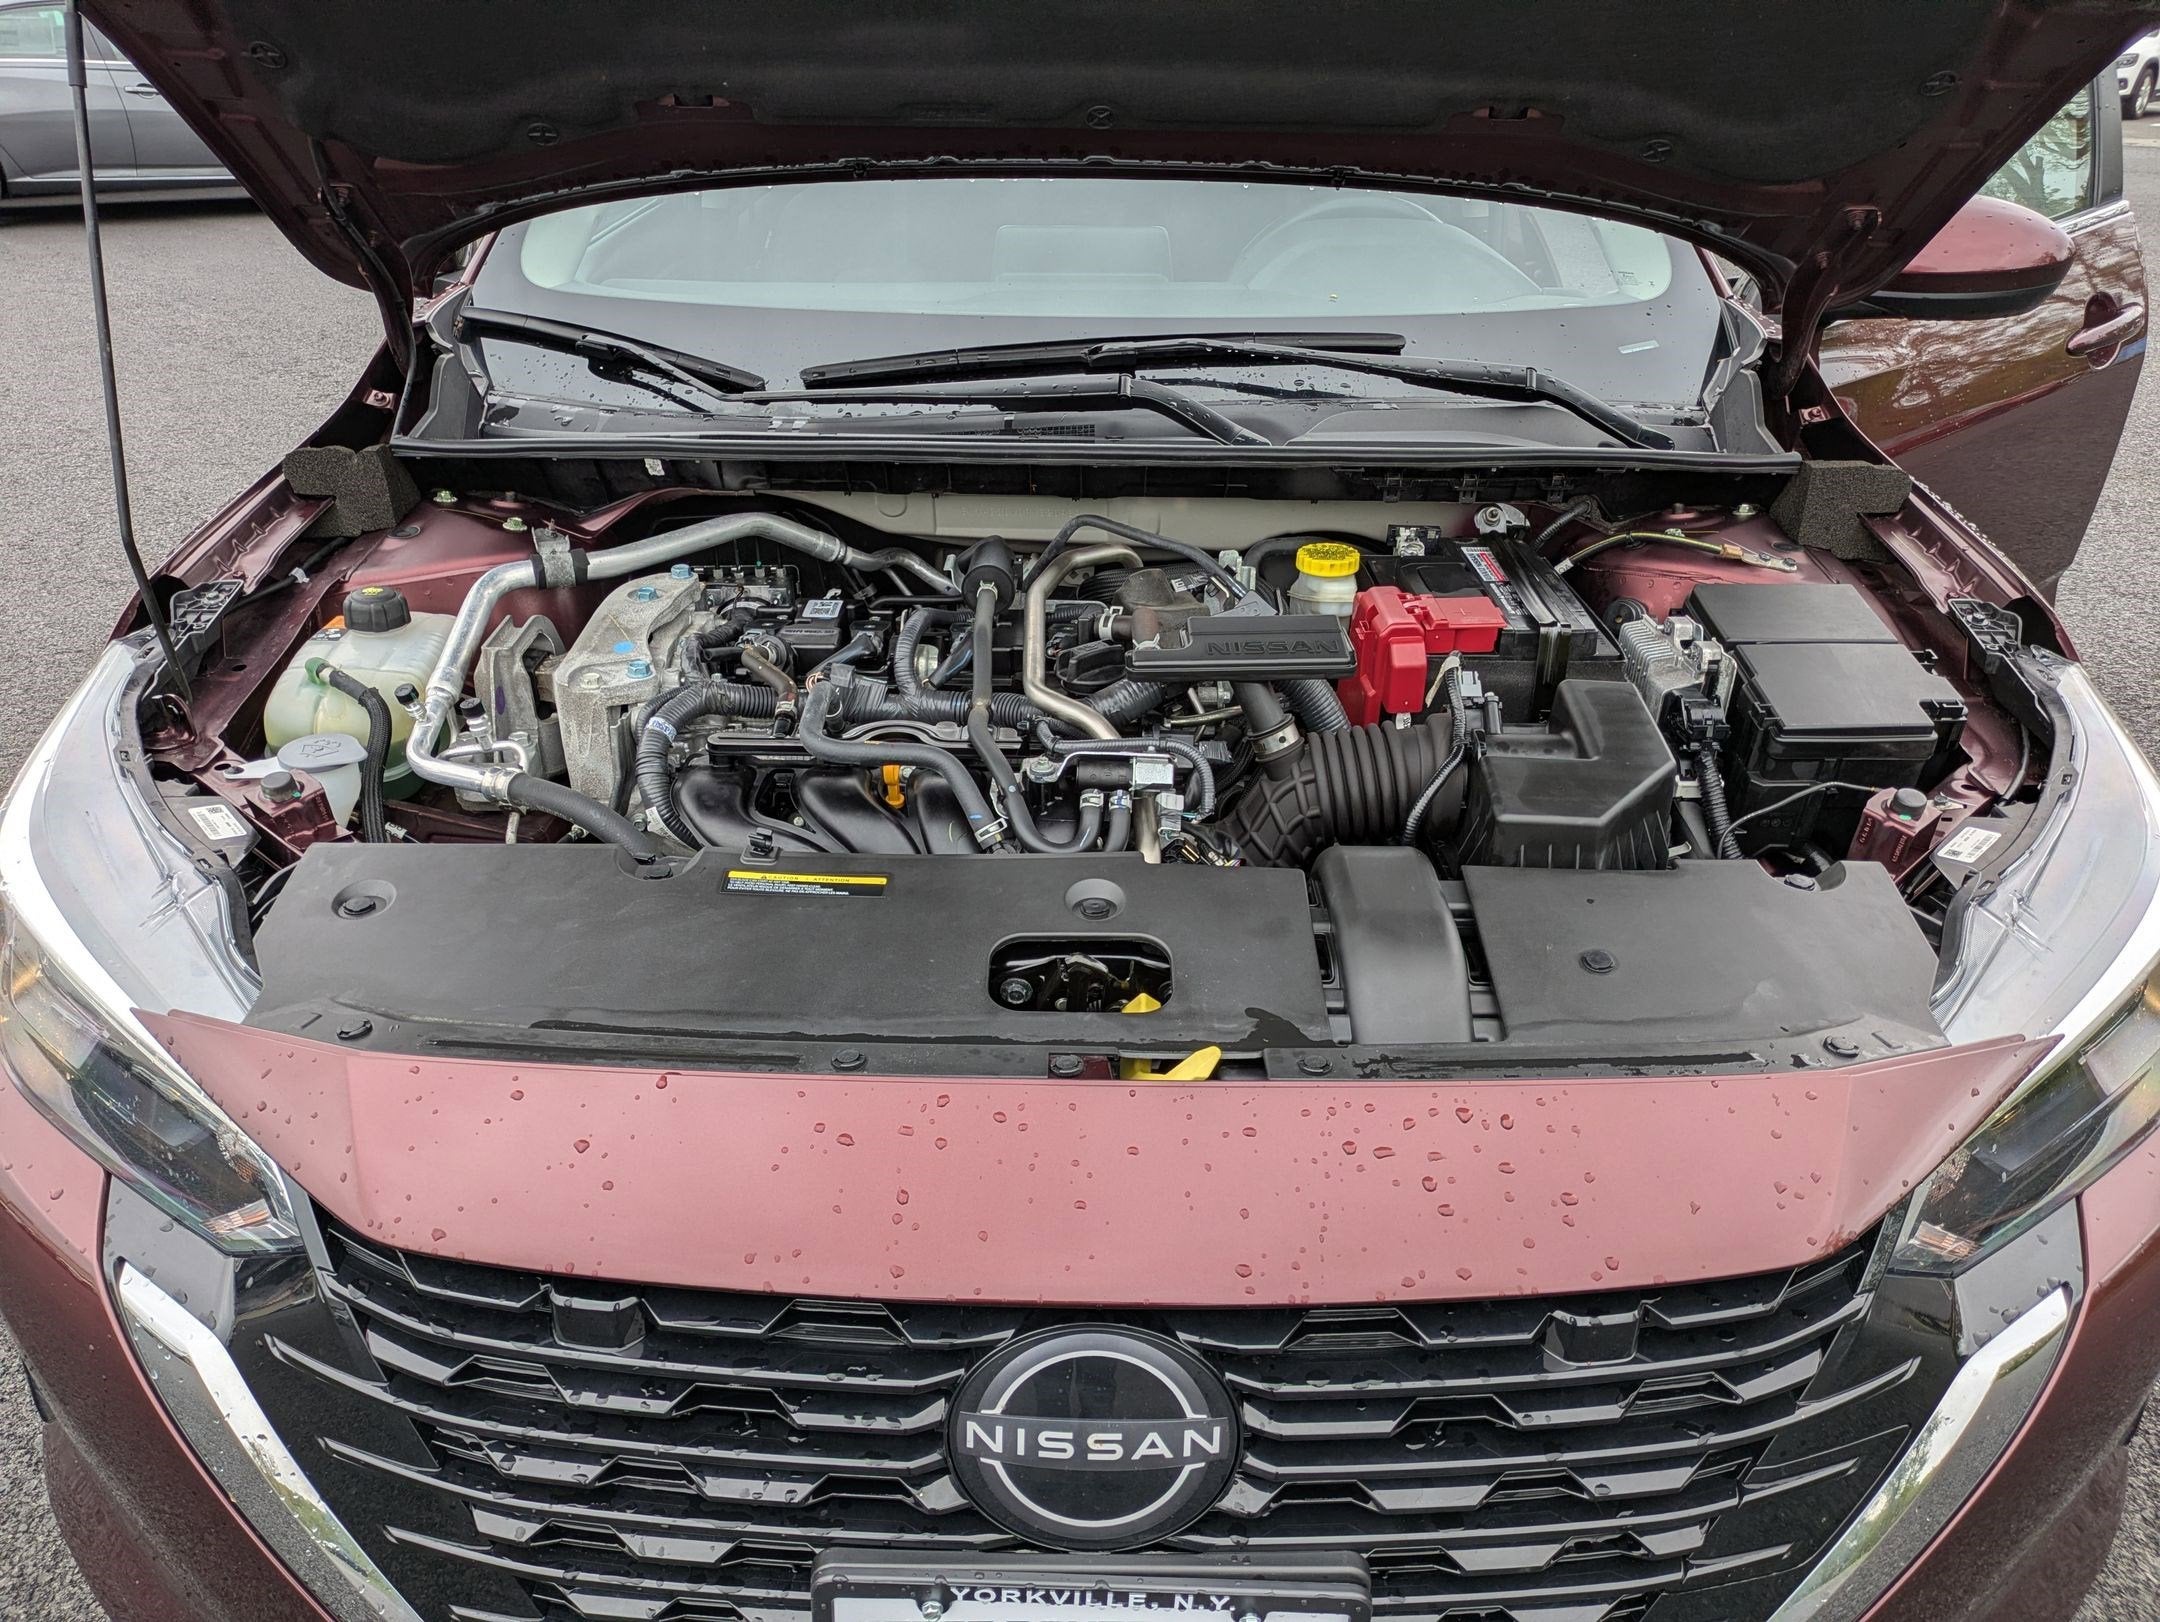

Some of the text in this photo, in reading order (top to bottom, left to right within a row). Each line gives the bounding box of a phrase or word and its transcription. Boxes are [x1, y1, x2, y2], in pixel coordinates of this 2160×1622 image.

[1207, 639, 1340, 655] NISSAN
[966, 1421, 1220, 1461] NISSAN
[950, 1587, 1236, 1611] YORKVILLE, N.Y.
